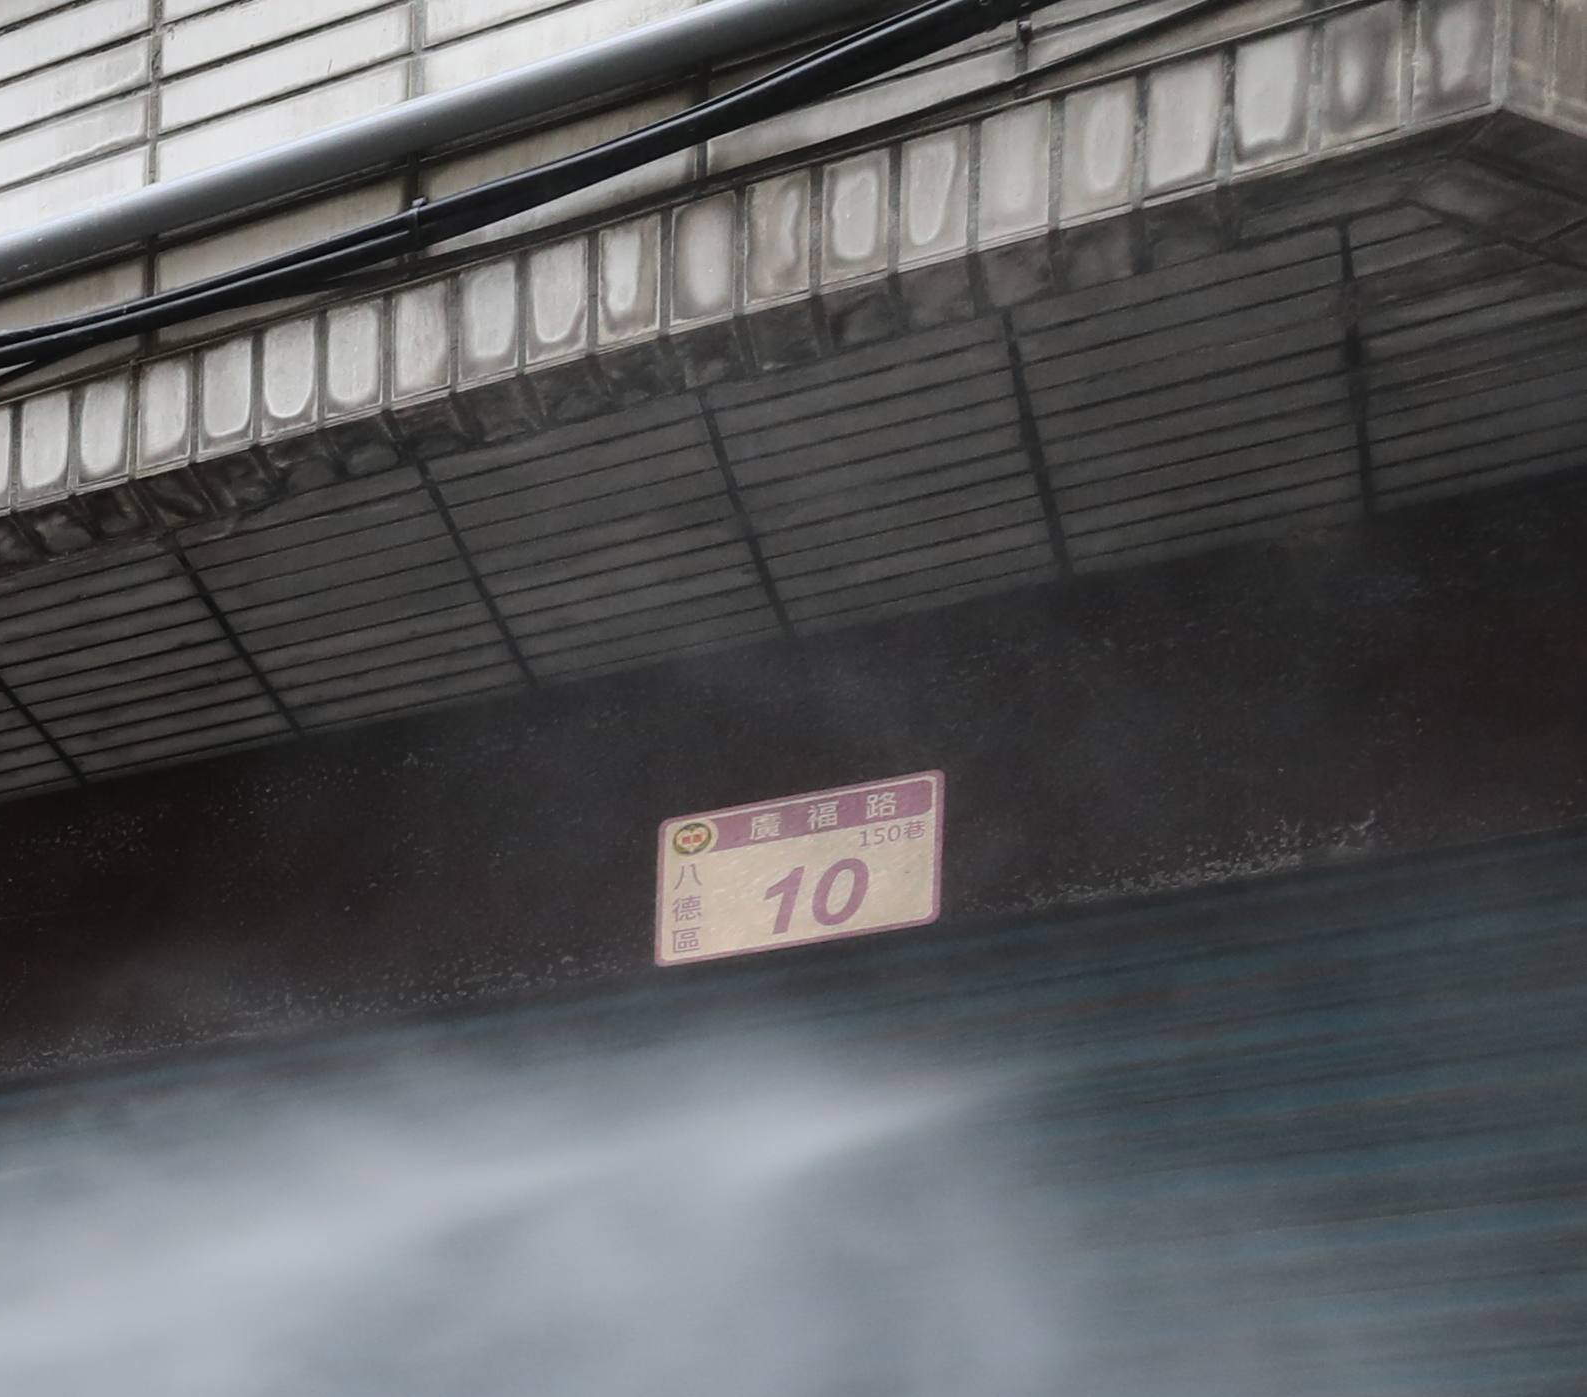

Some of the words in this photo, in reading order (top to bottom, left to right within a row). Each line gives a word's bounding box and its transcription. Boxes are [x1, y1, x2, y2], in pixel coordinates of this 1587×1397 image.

[749, 791, 897, 841] 廣福路
[859, 820, 926, 848] 150巷
[672, 863, 703, 953] 八德區
[763, 858, 869, 935] 10
